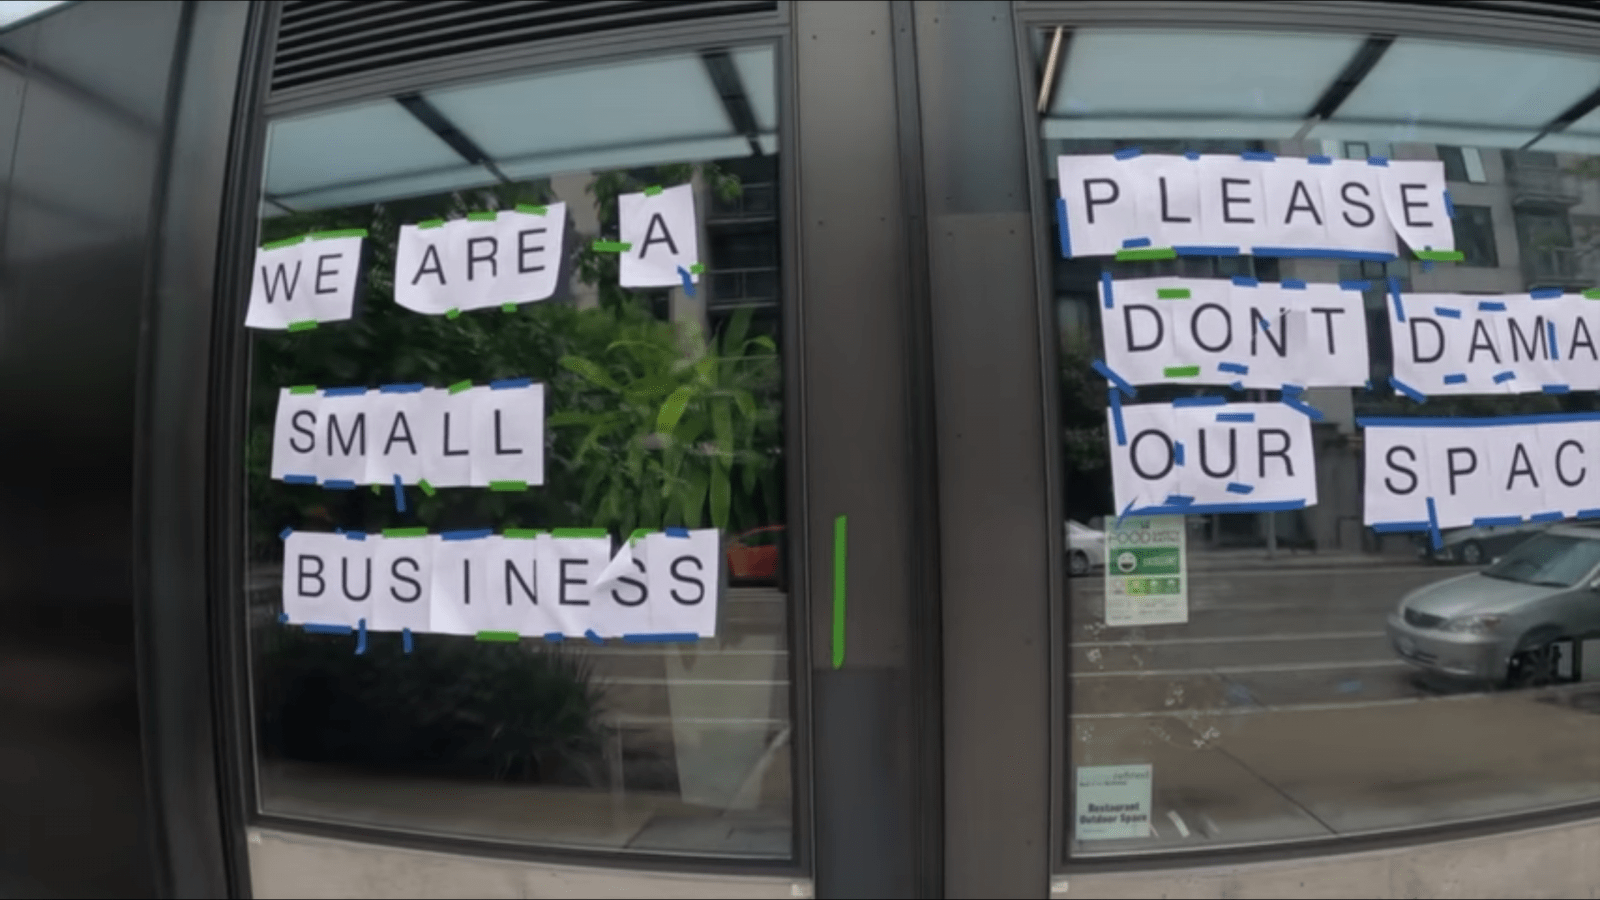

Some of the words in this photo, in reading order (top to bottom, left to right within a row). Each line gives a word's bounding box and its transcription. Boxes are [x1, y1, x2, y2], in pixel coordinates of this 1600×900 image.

[1083, 177, 1433, 228] PLEASE
[262, 254, 342, 303] WE
[411, 228, 547, 286] ARE
[638, 212, 678, 259] A
[1123, 303, 1345, 357] DONT
[290, 409, 523, 456] SMALL
[1129, 428, 1294, 480] OUR
[1384, 441, 1587, 495] SPAC
[297, 554, 706, 607] BUSINESS
